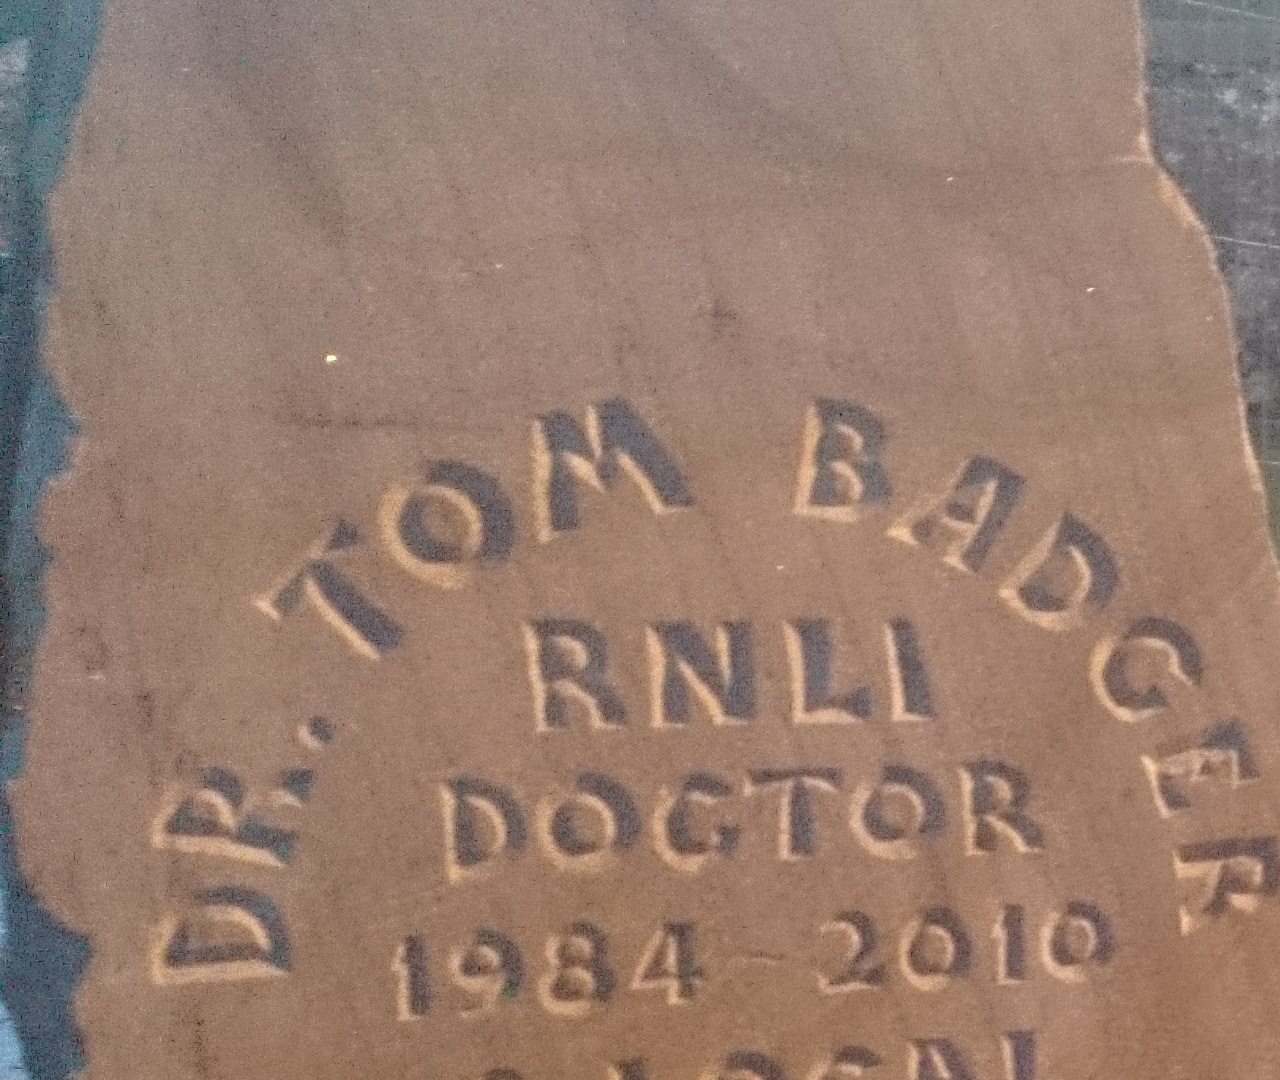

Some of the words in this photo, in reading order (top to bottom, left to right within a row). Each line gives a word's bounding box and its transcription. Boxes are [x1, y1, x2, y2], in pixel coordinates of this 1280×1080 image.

[152, 714, 336, 987] DR.
[252, 398, 694, 662] TOM
[523, 616, 936, 733] RNLI
[440, 760, 1046, 882] DOCTOR
[392, 918, 704, 1021] 1984
[816, 900, 1115, 991] 2010
